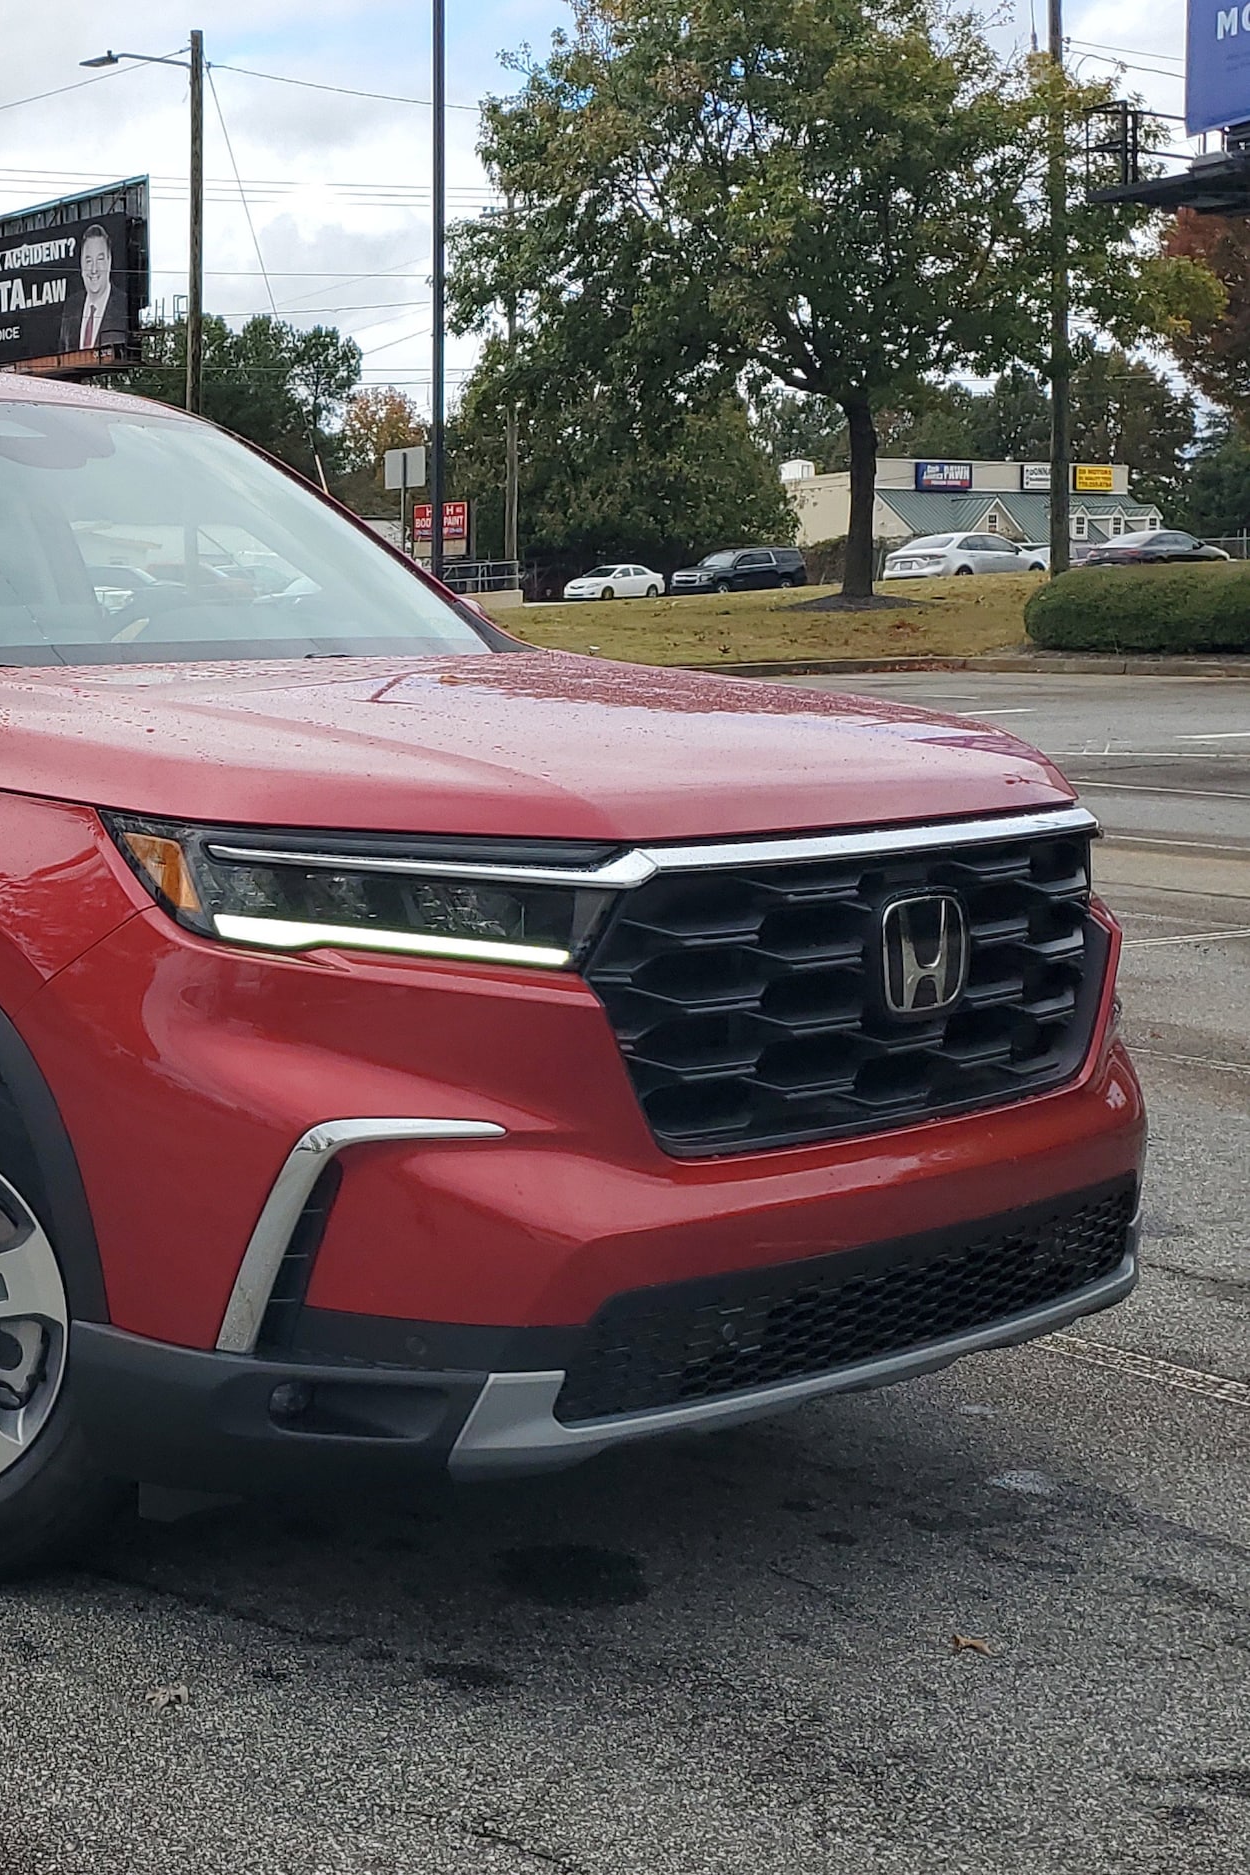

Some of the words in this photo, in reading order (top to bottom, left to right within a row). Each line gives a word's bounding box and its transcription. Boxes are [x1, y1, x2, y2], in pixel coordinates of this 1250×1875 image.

[3, 237, 77, 270] ACCIDENT?
[445, 505, 454, 516] H
[415, 517, 432, 528] BOD
[443, 515, 464, 526] PAINT
